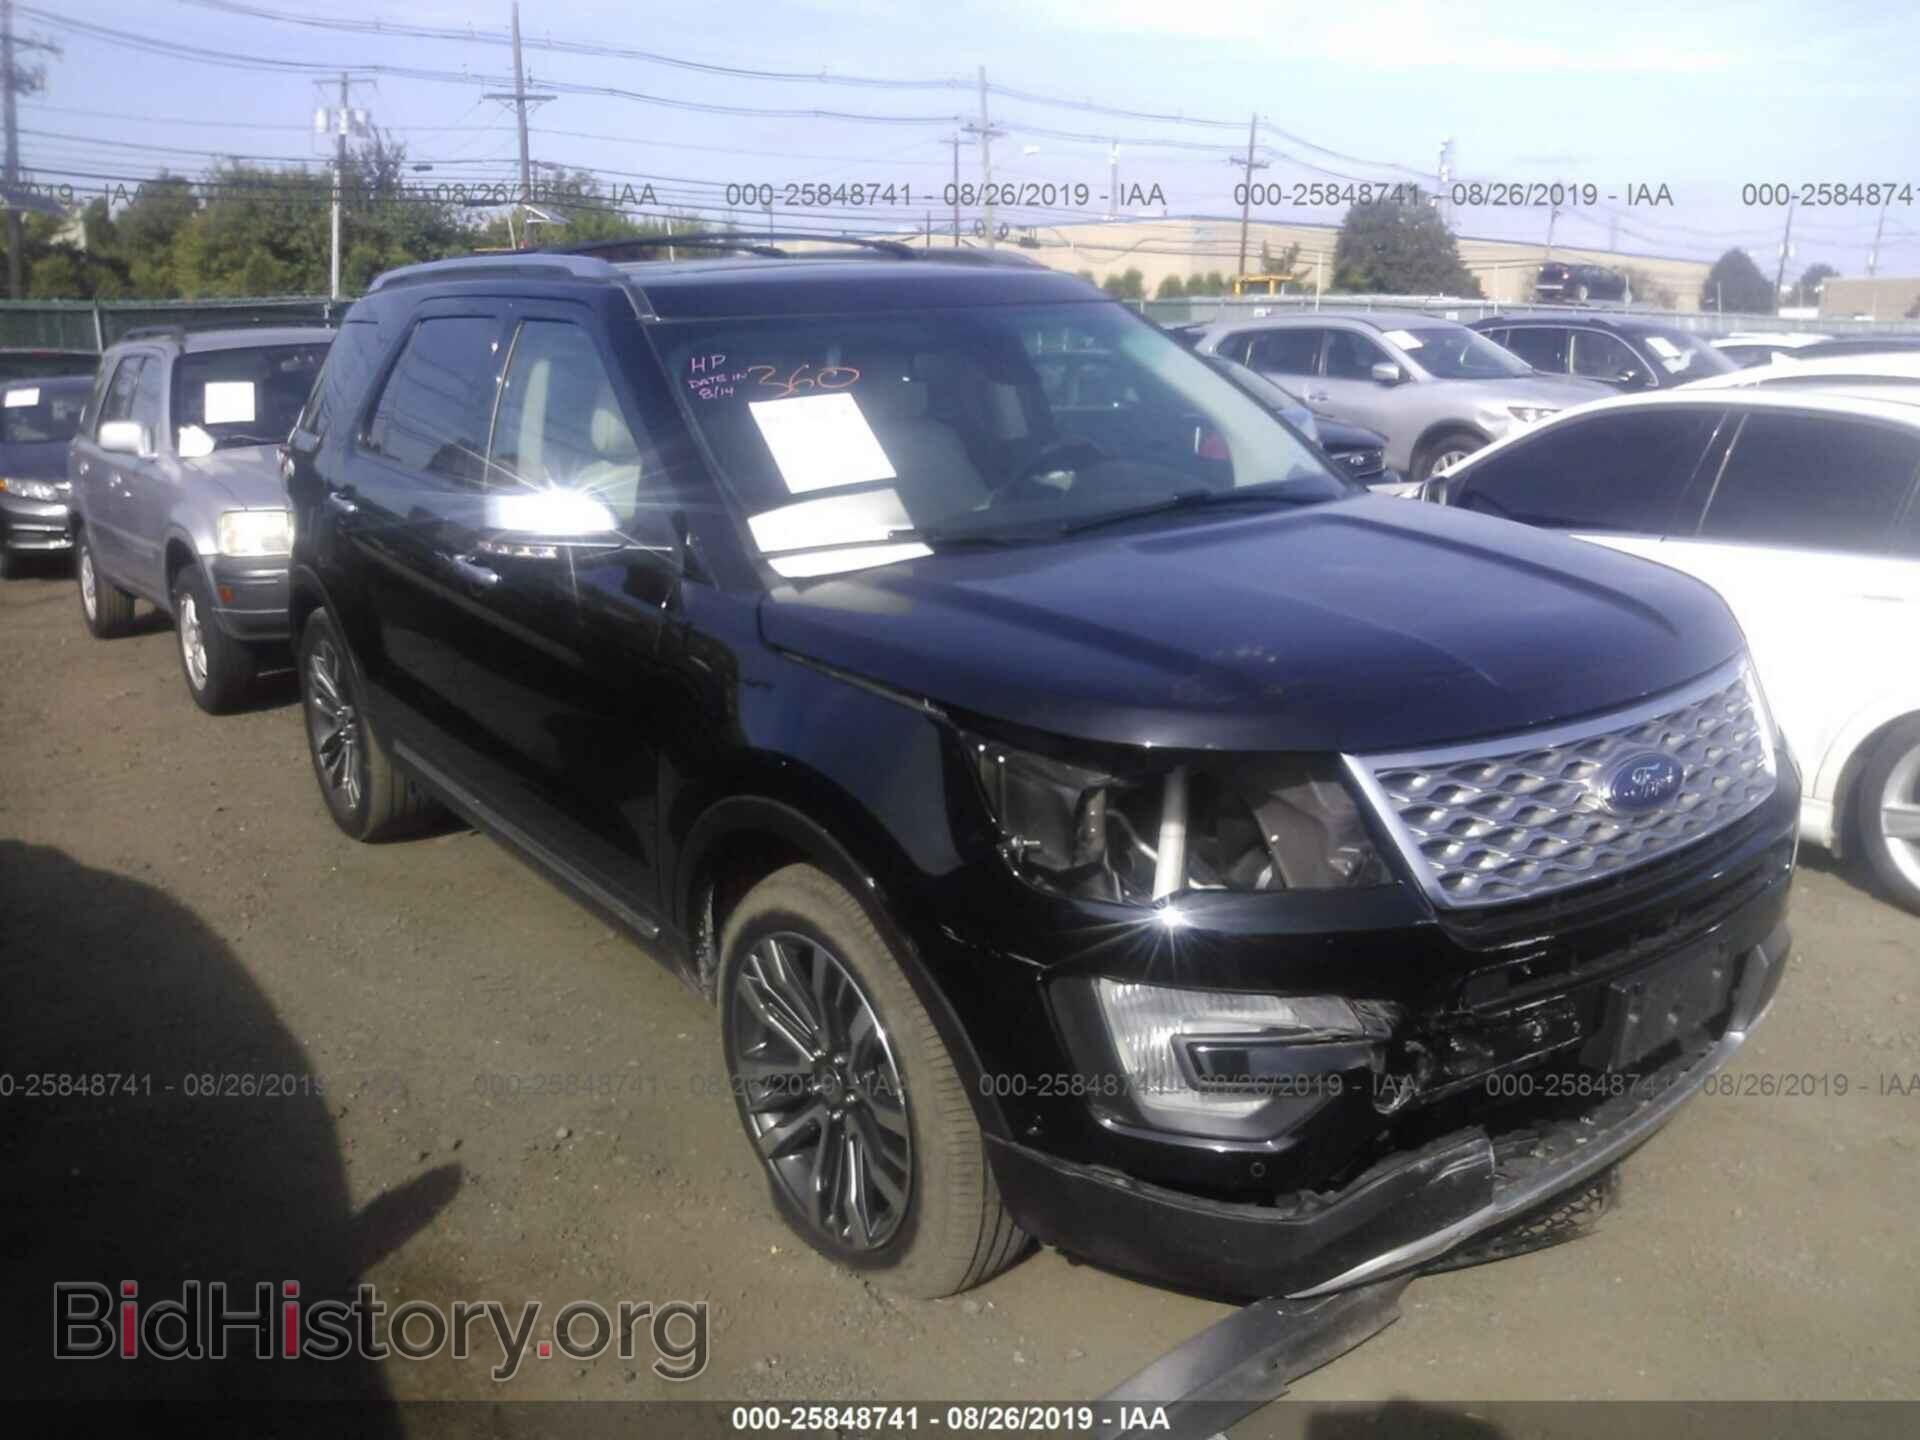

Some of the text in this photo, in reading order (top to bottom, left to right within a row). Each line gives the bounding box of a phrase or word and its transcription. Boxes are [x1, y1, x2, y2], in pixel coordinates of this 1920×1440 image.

[690, 354, 726, 373] HP
[687, 373, 727, 389] DATE
[748, 364, 861, 398] 360
[699, 385, 735, 400] 8/14
